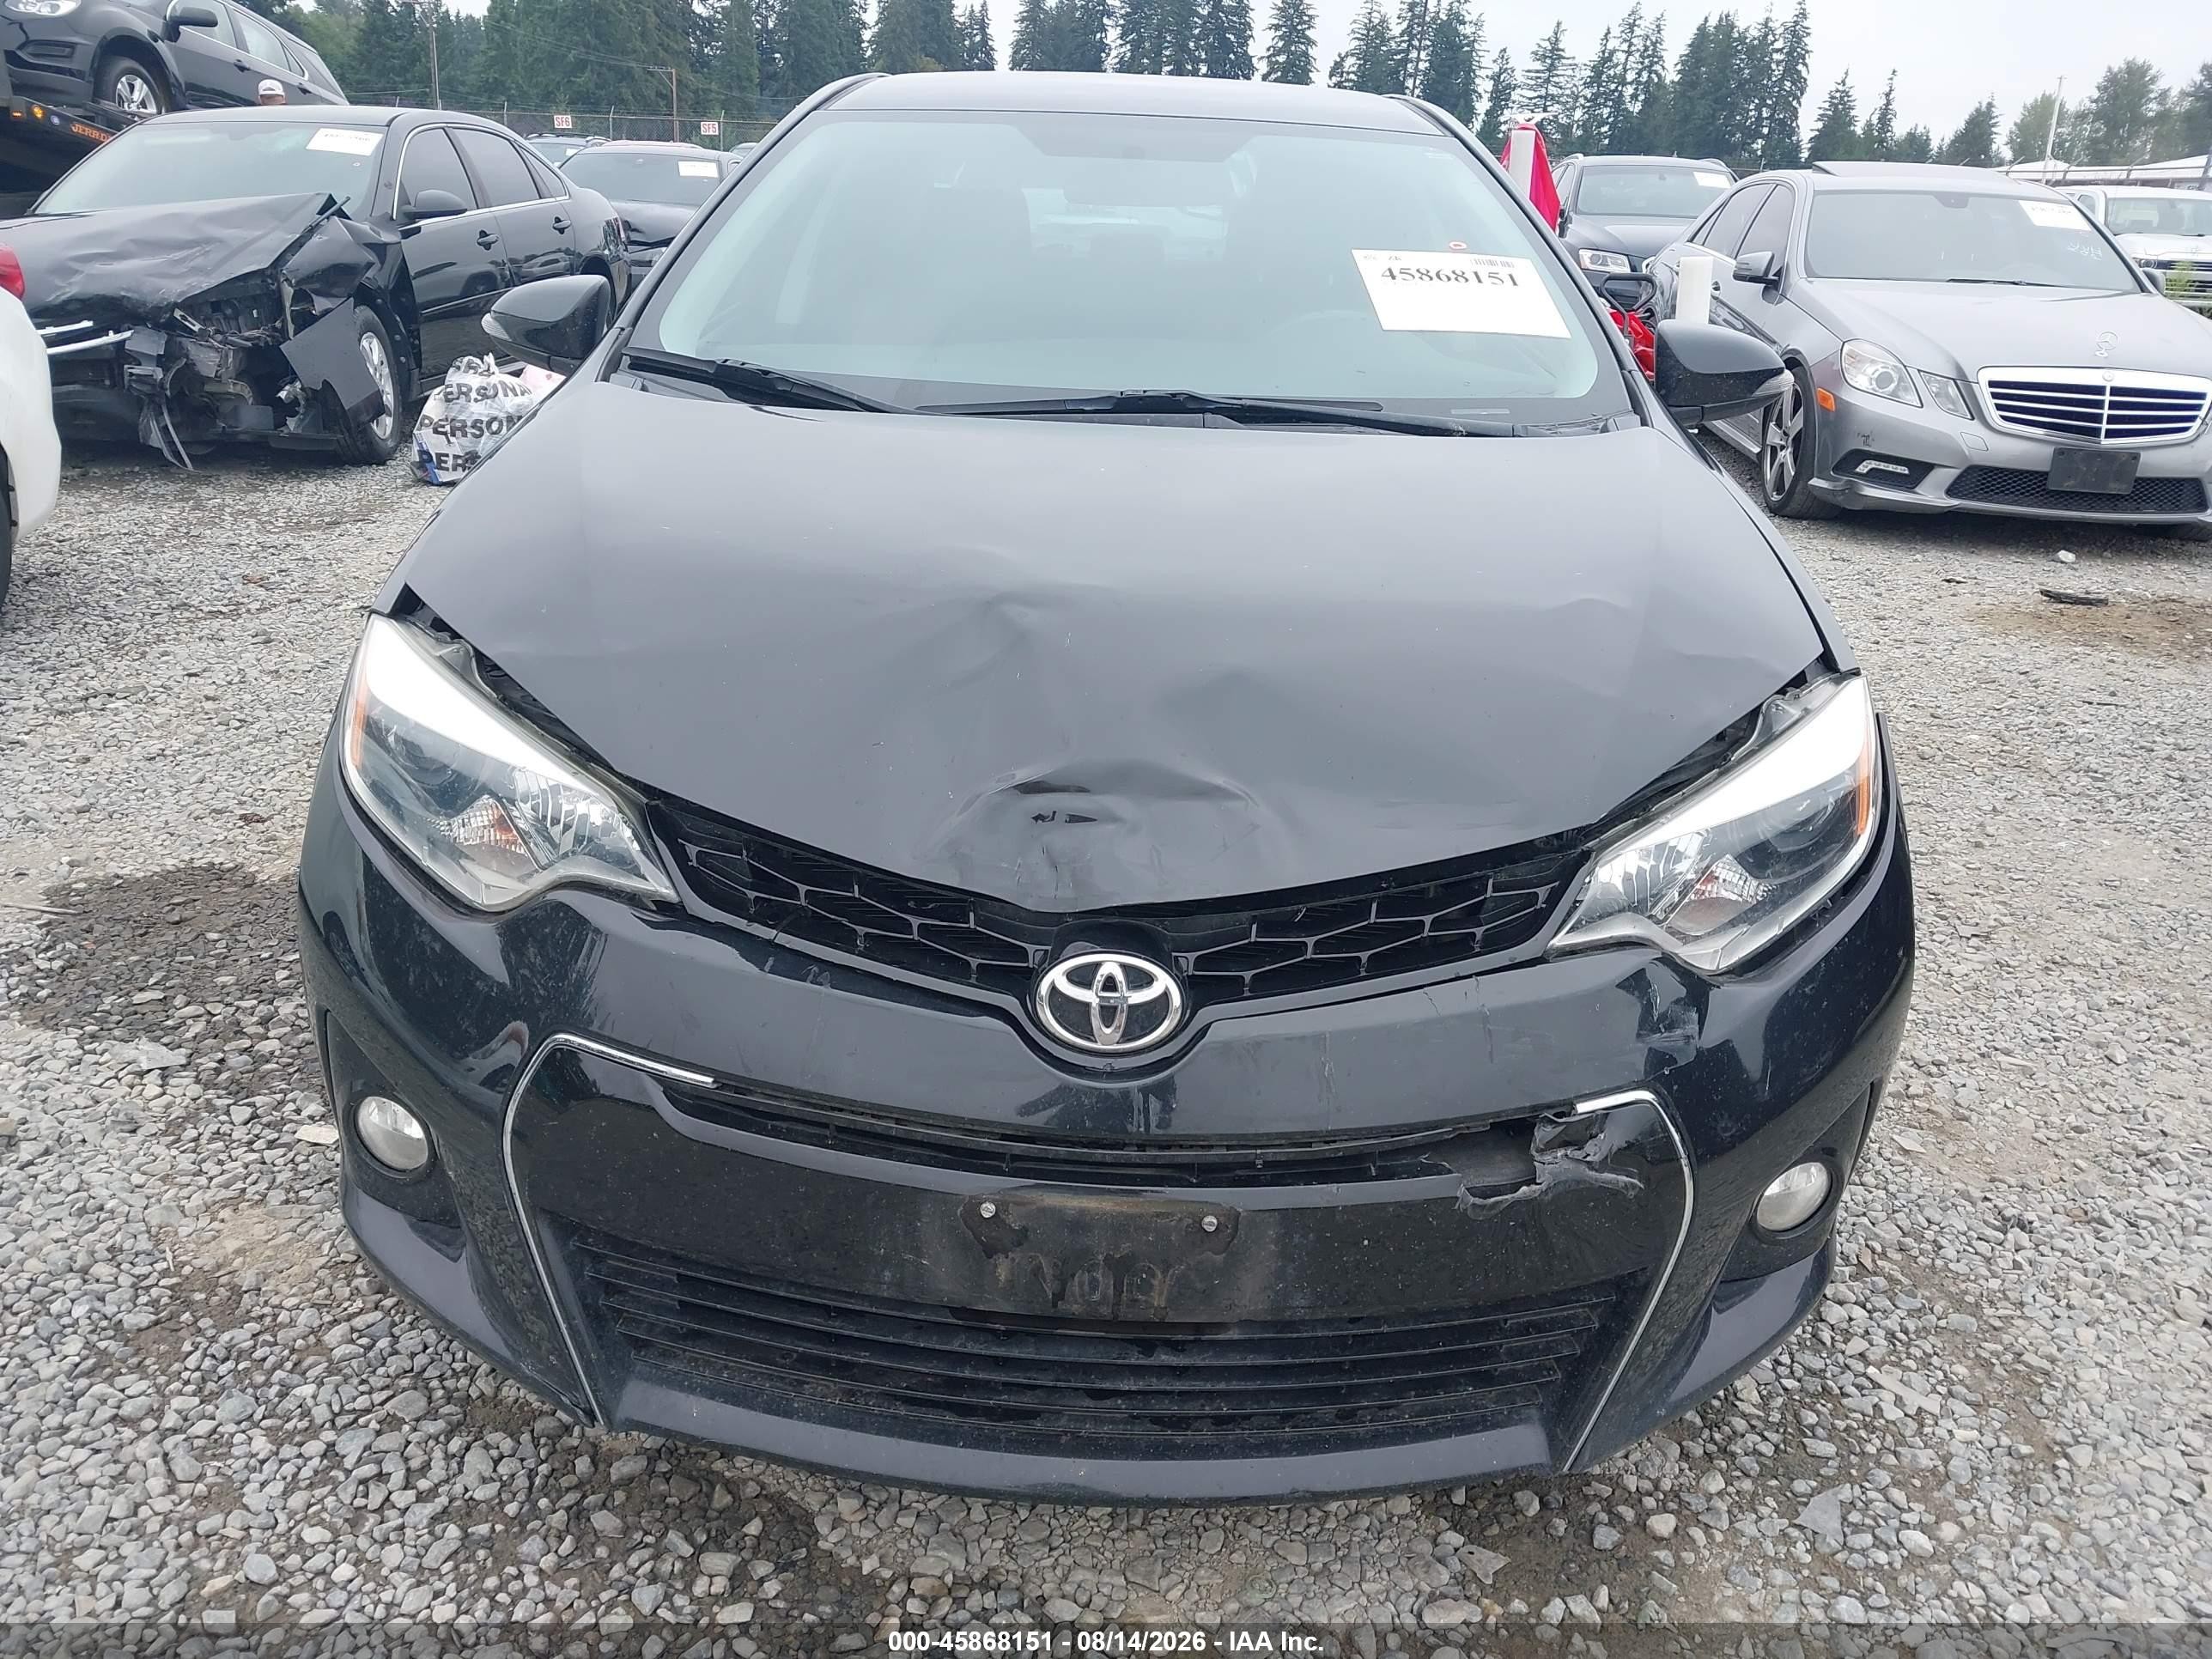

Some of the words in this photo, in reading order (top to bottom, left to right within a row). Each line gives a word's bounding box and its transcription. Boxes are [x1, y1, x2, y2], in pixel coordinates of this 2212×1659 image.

[556, 116, 571, 127] SF6
[702, 123, 717, 134] SF5
[1381, 267, 1519, 287] 45868151
